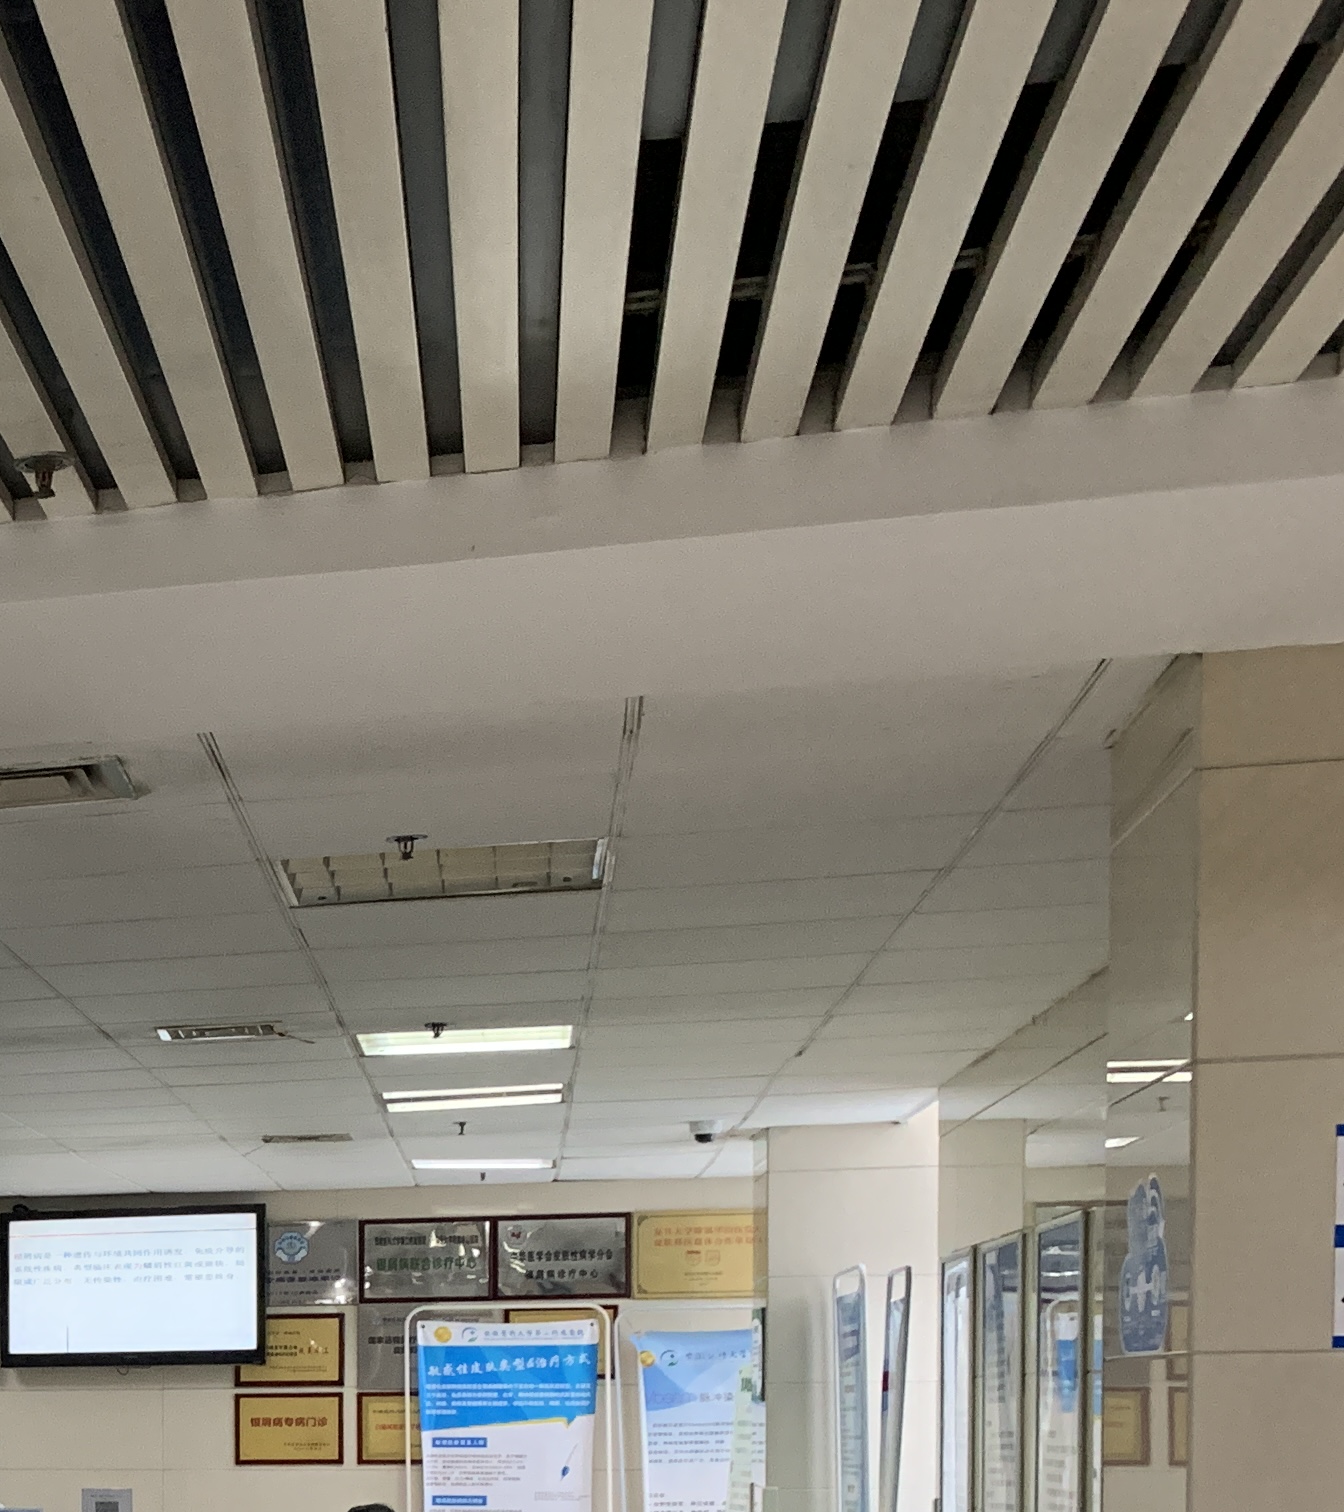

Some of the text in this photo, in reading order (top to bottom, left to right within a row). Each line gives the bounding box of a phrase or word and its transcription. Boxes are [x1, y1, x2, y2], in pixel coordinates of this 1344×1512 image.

[250, 1416, 328, 1428] 银屑病专病门诊
